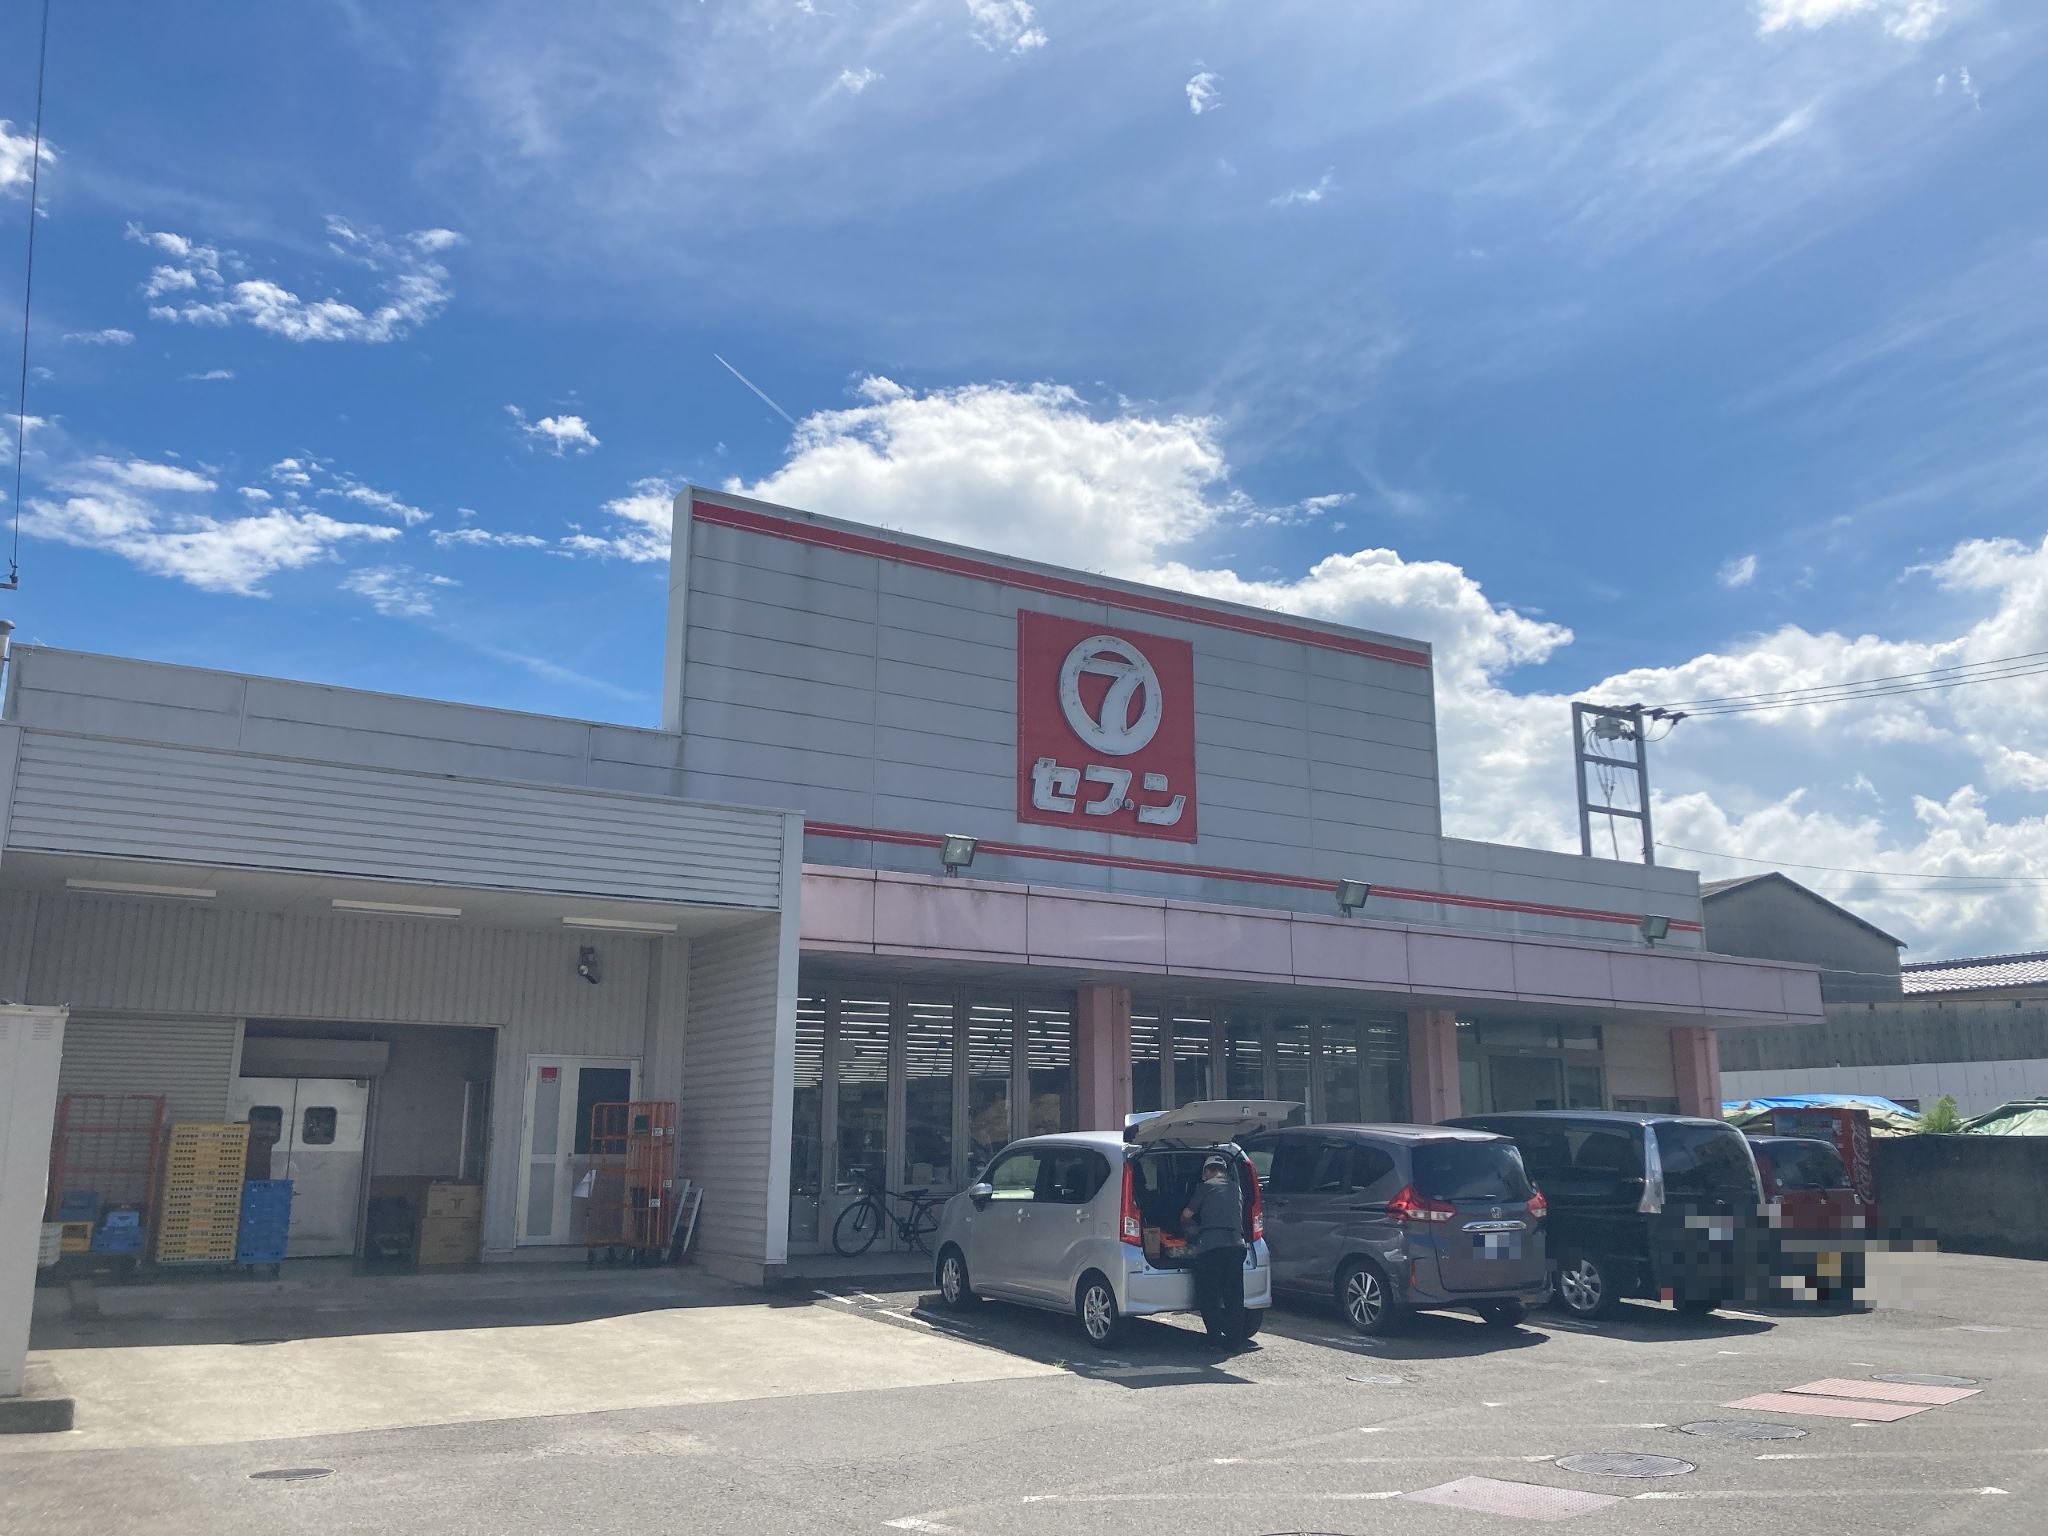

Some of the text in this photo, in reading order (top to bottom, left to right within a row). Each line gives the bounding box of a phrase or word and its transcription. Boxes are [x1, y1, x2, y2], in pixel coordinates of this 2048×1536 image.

[1069, 647, 1153, 746] 7
[1033, 757, 1187, 826] セブン
